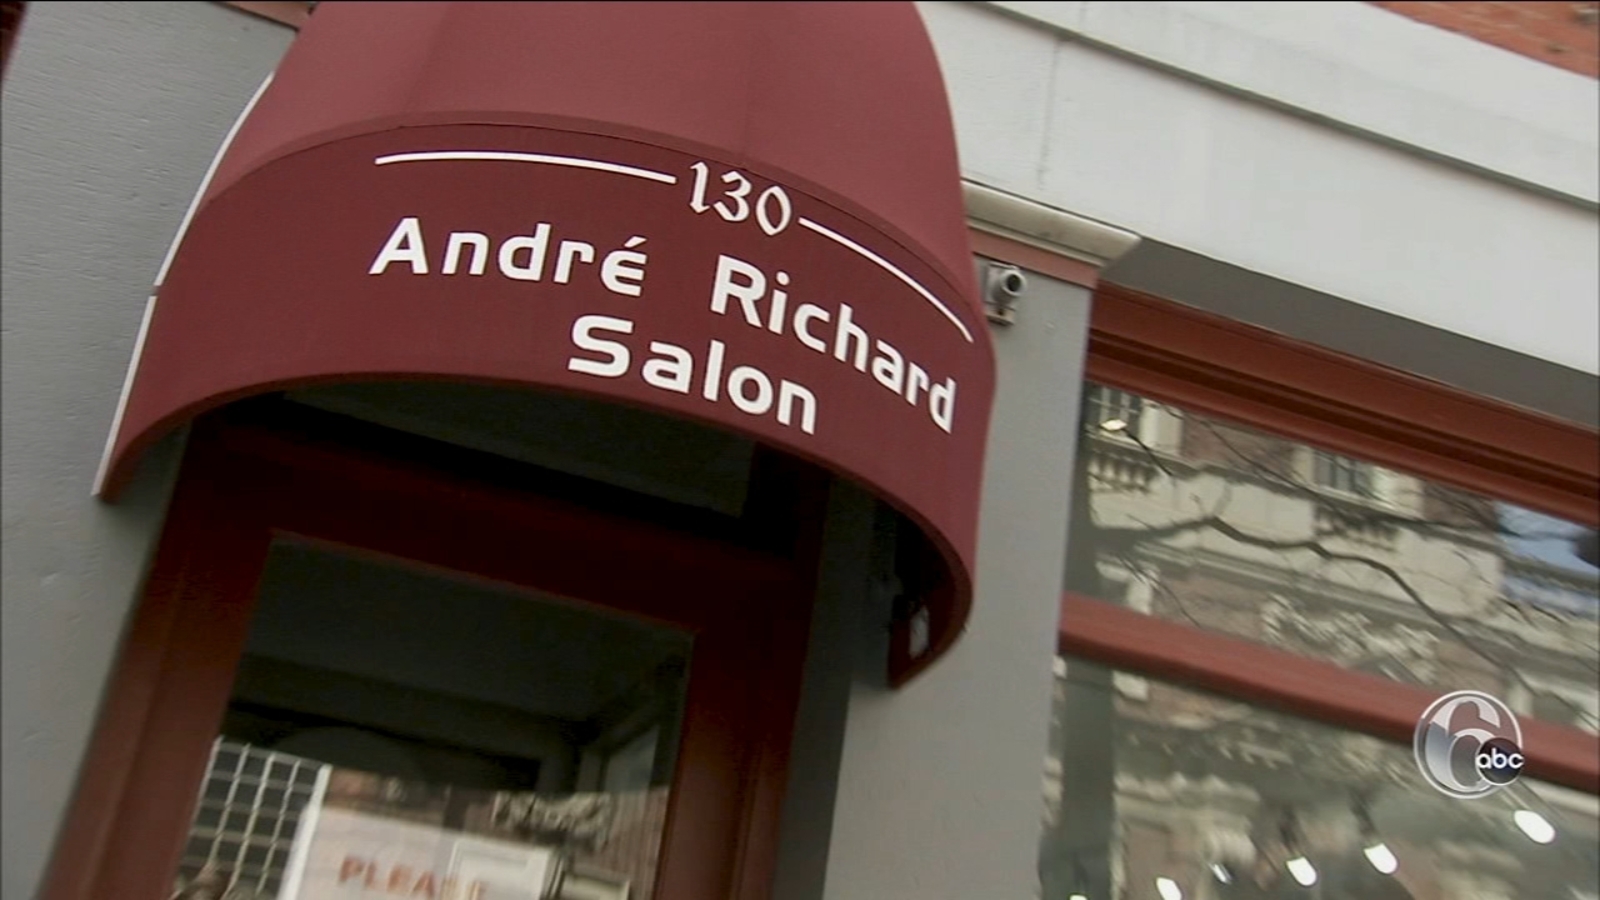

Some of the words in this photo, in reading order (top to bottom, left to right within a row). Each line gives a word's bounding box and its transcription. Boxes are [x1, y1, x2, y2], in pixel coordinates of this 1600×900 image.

[689, 161, 792, 236] 130
[369, 217, 648, 297] André
[710, 254, 956, 434] Richard
[568, 315, 817, 435] Salon
